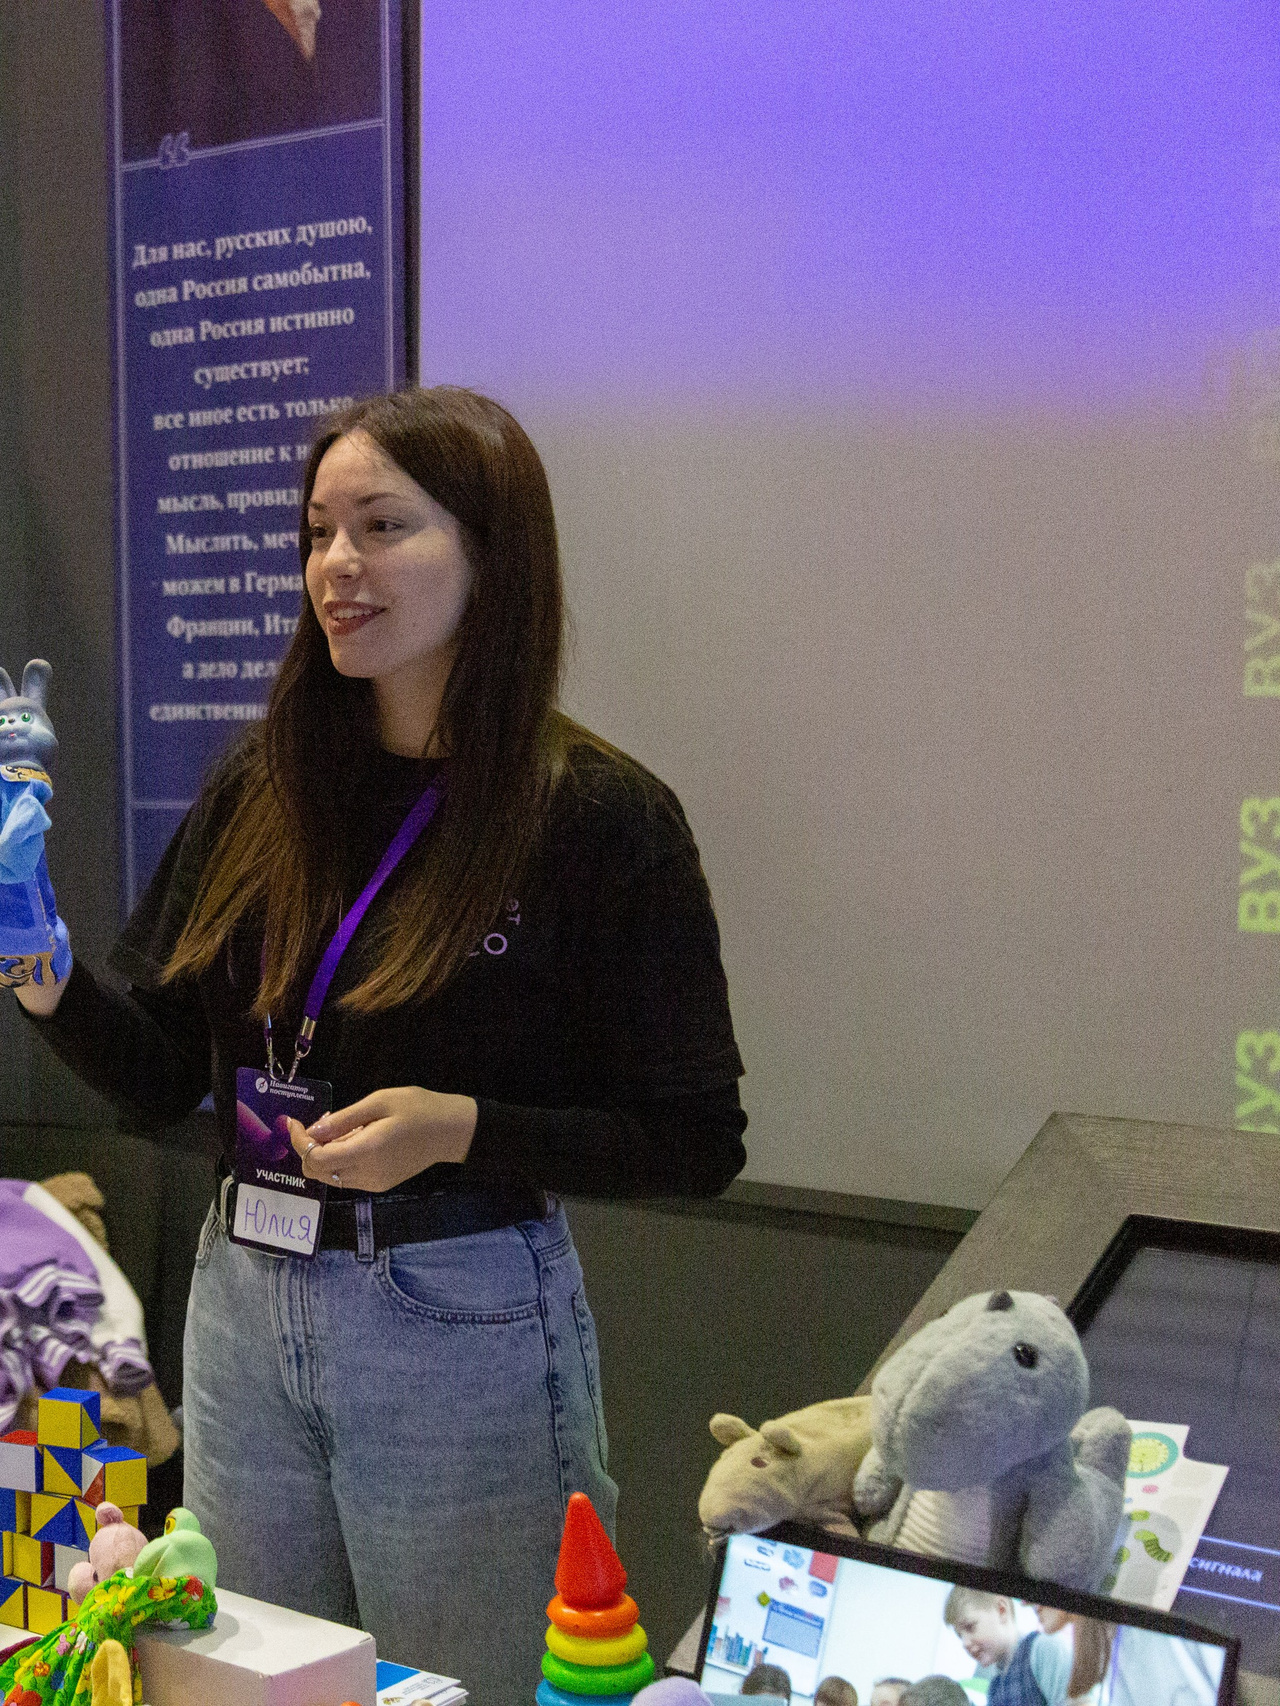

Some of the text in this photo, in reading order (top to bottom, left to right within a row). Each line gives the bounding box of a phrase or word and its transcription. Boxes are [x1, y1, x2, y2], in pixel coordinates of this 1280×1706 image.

[132, 245, 168, 268] Для
[215, 227, 292, 260] русских
[134, 285, 178, 308] одна
[182, 275, 248, 301] Россия
[149, 307, 355, 348] одна Россия истинно
[153, 413, 185, 431] все
[188, 407, 233, 428] иное
[236, 403, 281, 424] есть
[169, 446, 275, 471] отношение
[279, 446, 293, 463] к
[227, 488, 304, 514] провид
[228, 576, 241, 594] в
[244, 570, 304, 599] Герма
[182, 662, 194, 680] а
[256, 1168, 306, 1189] УЧАСТНИК
[244, 1197, 314, 1246] Юлия
